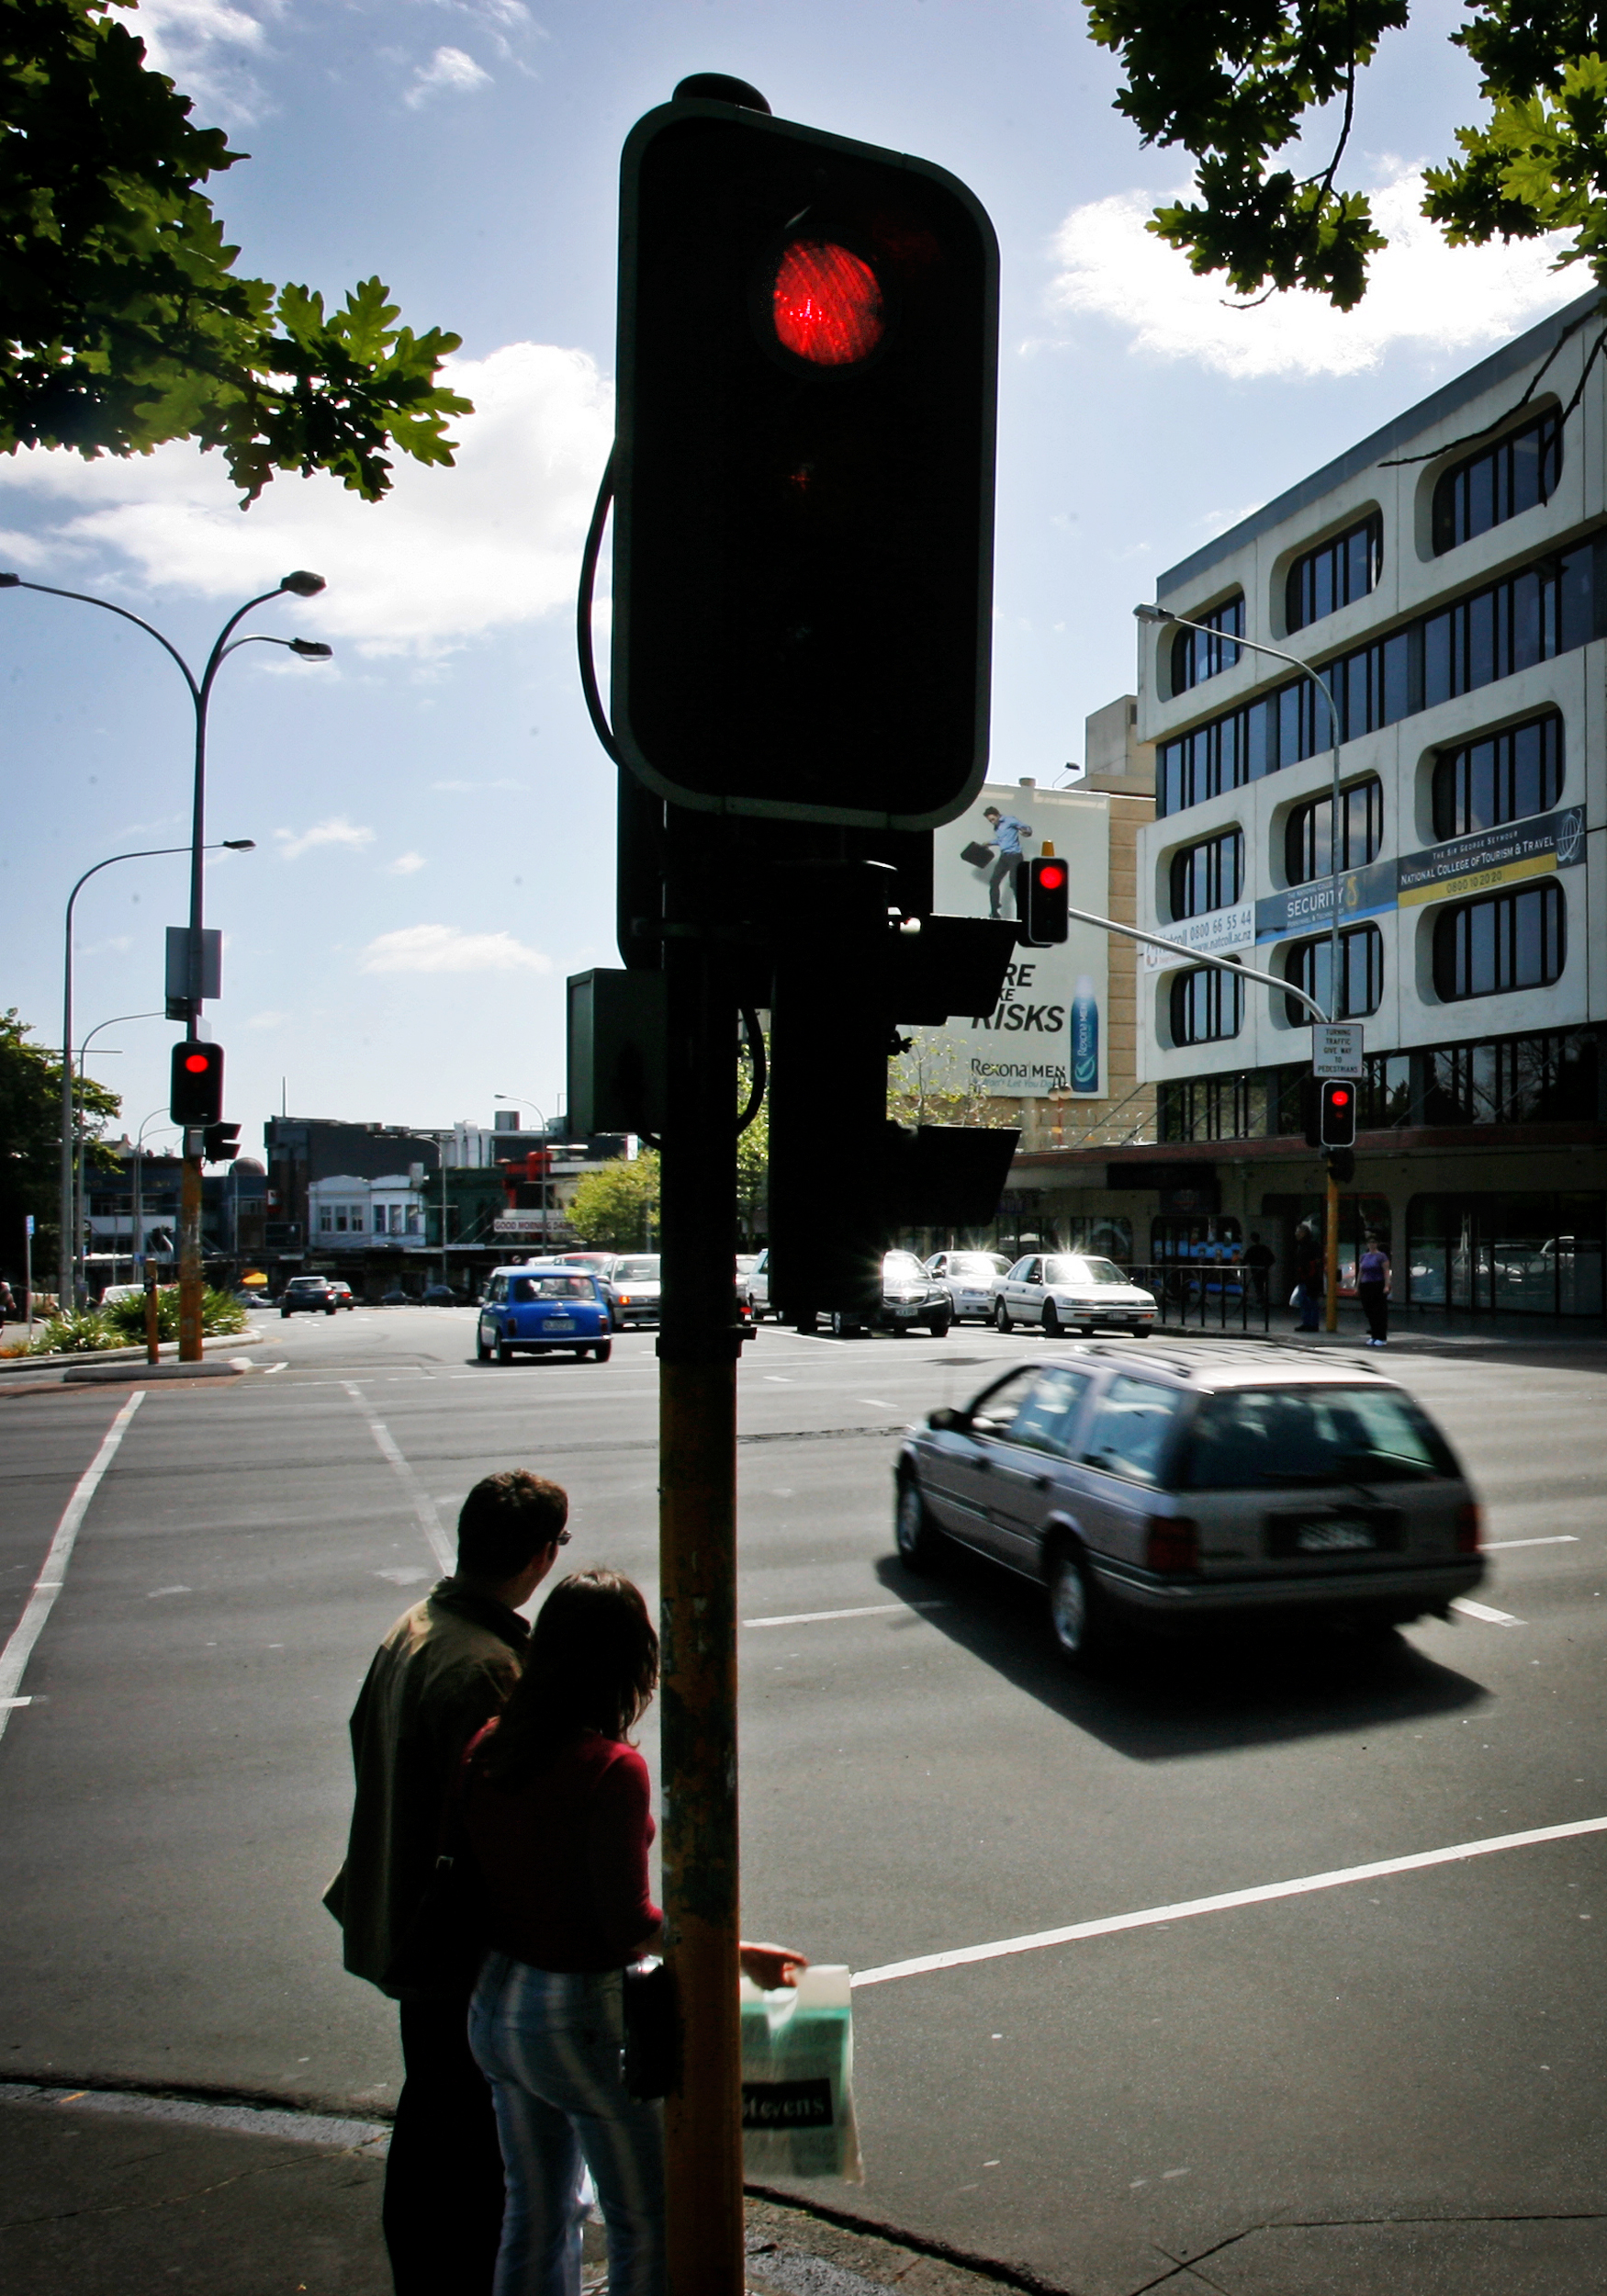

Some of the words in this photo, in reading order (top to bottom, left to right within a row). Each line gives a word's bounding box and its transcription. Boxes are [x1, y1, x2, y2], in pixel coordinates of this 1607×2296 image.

[1459, 840, 1485, 855] GEORGE
[1487, 830, 1518, 845] SEYMOUR
[1400, 867, 1435, 886] NATIONAL
[1437, 856, 1469, 876] COLLEGE
[1470, 856, 1481, 866] OF
[1481, 847, 1513, 864] TOURISM
[1514, 843, 1522, 855] &
[1523, 835, 1555, 853] TRAVEL
[1446, 878, 1468, 895] 0800
[1469, 877, 1478, 888] 10
[1478, 872, 1490, 886] 20
[1491, 870, 1502, 884] 20
[1287, 886, 1344, 918] SECURITY
[1189, 922, 1210, 941] 0800
[1212, 917, 1223, 935] 66
[1226, 914, 1237, 931] 55
[1241, 909, 1252, 926] 44
[971, 1058, 1028, 1077] Rexona
[1032, 1065, 1065, 1078] MEN
[1317, 1065, 1358, 1074] PEDESTRIANS
[495, 1221, 516, 1231] GOOD
